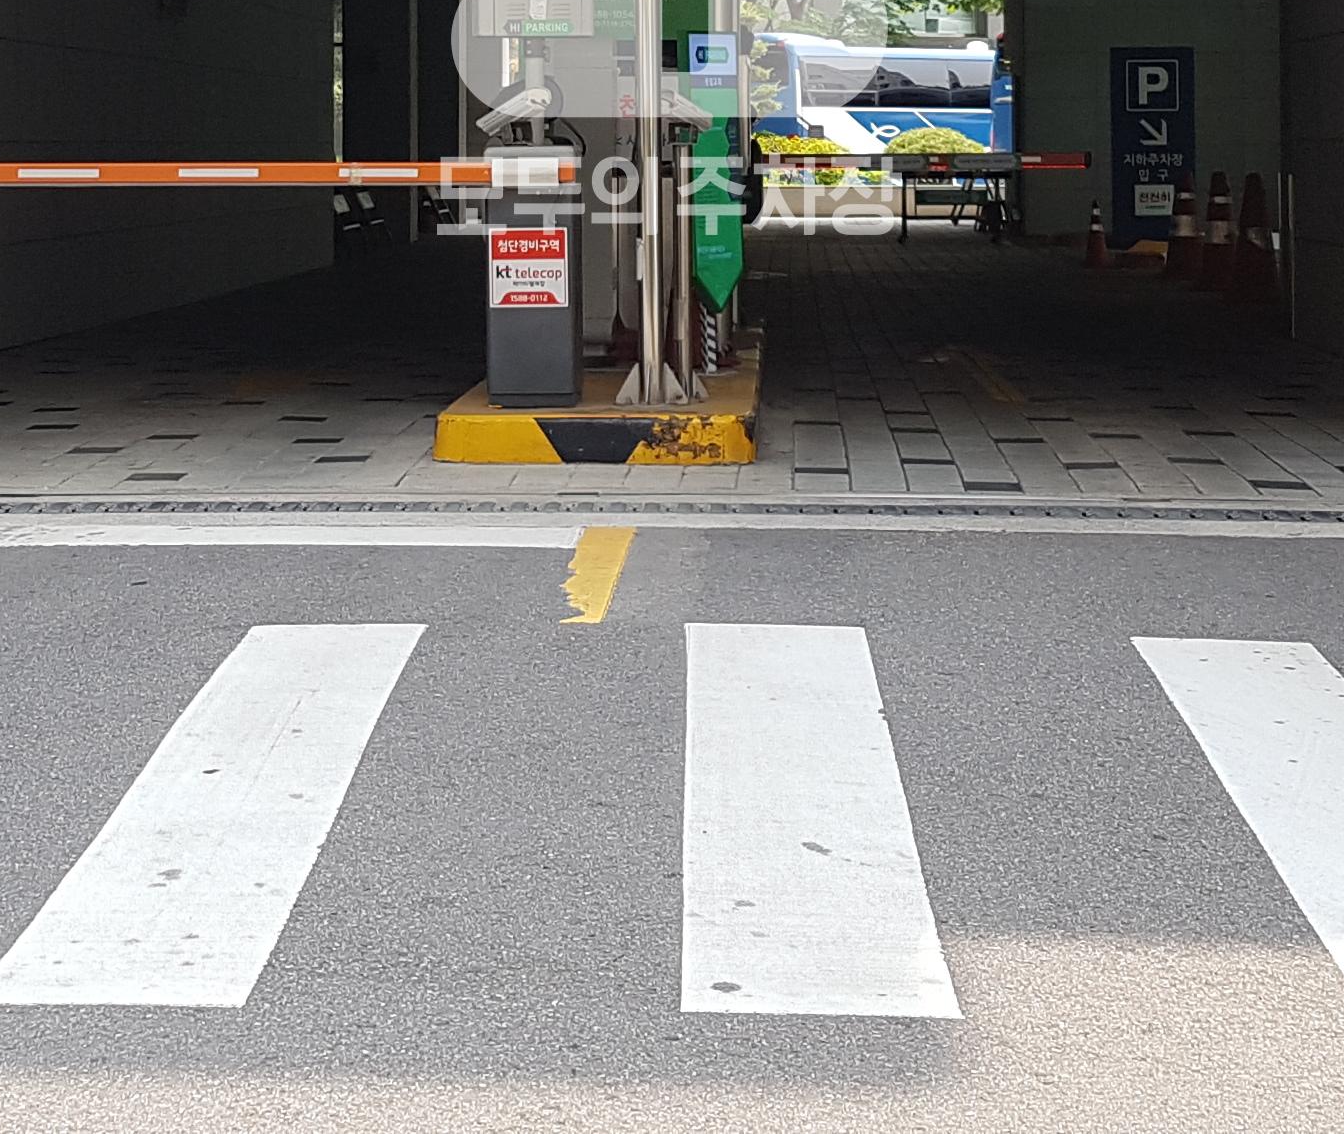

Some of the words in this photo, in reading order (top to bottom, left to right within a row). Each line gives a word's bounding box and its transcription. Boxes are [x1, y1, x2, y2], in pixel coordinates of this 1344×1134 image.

[510, 22, 521, 33] HI
[525, 21, 569, 33] PARKING
[1138, 66, 1169, 105] P
[1123, 152, 1184, 168] 지하주차장
[497, 239, 560, 253] 첨단경비구역
[496, 265, 512, 279] kt
[515, 267, 563, 281] telecop
